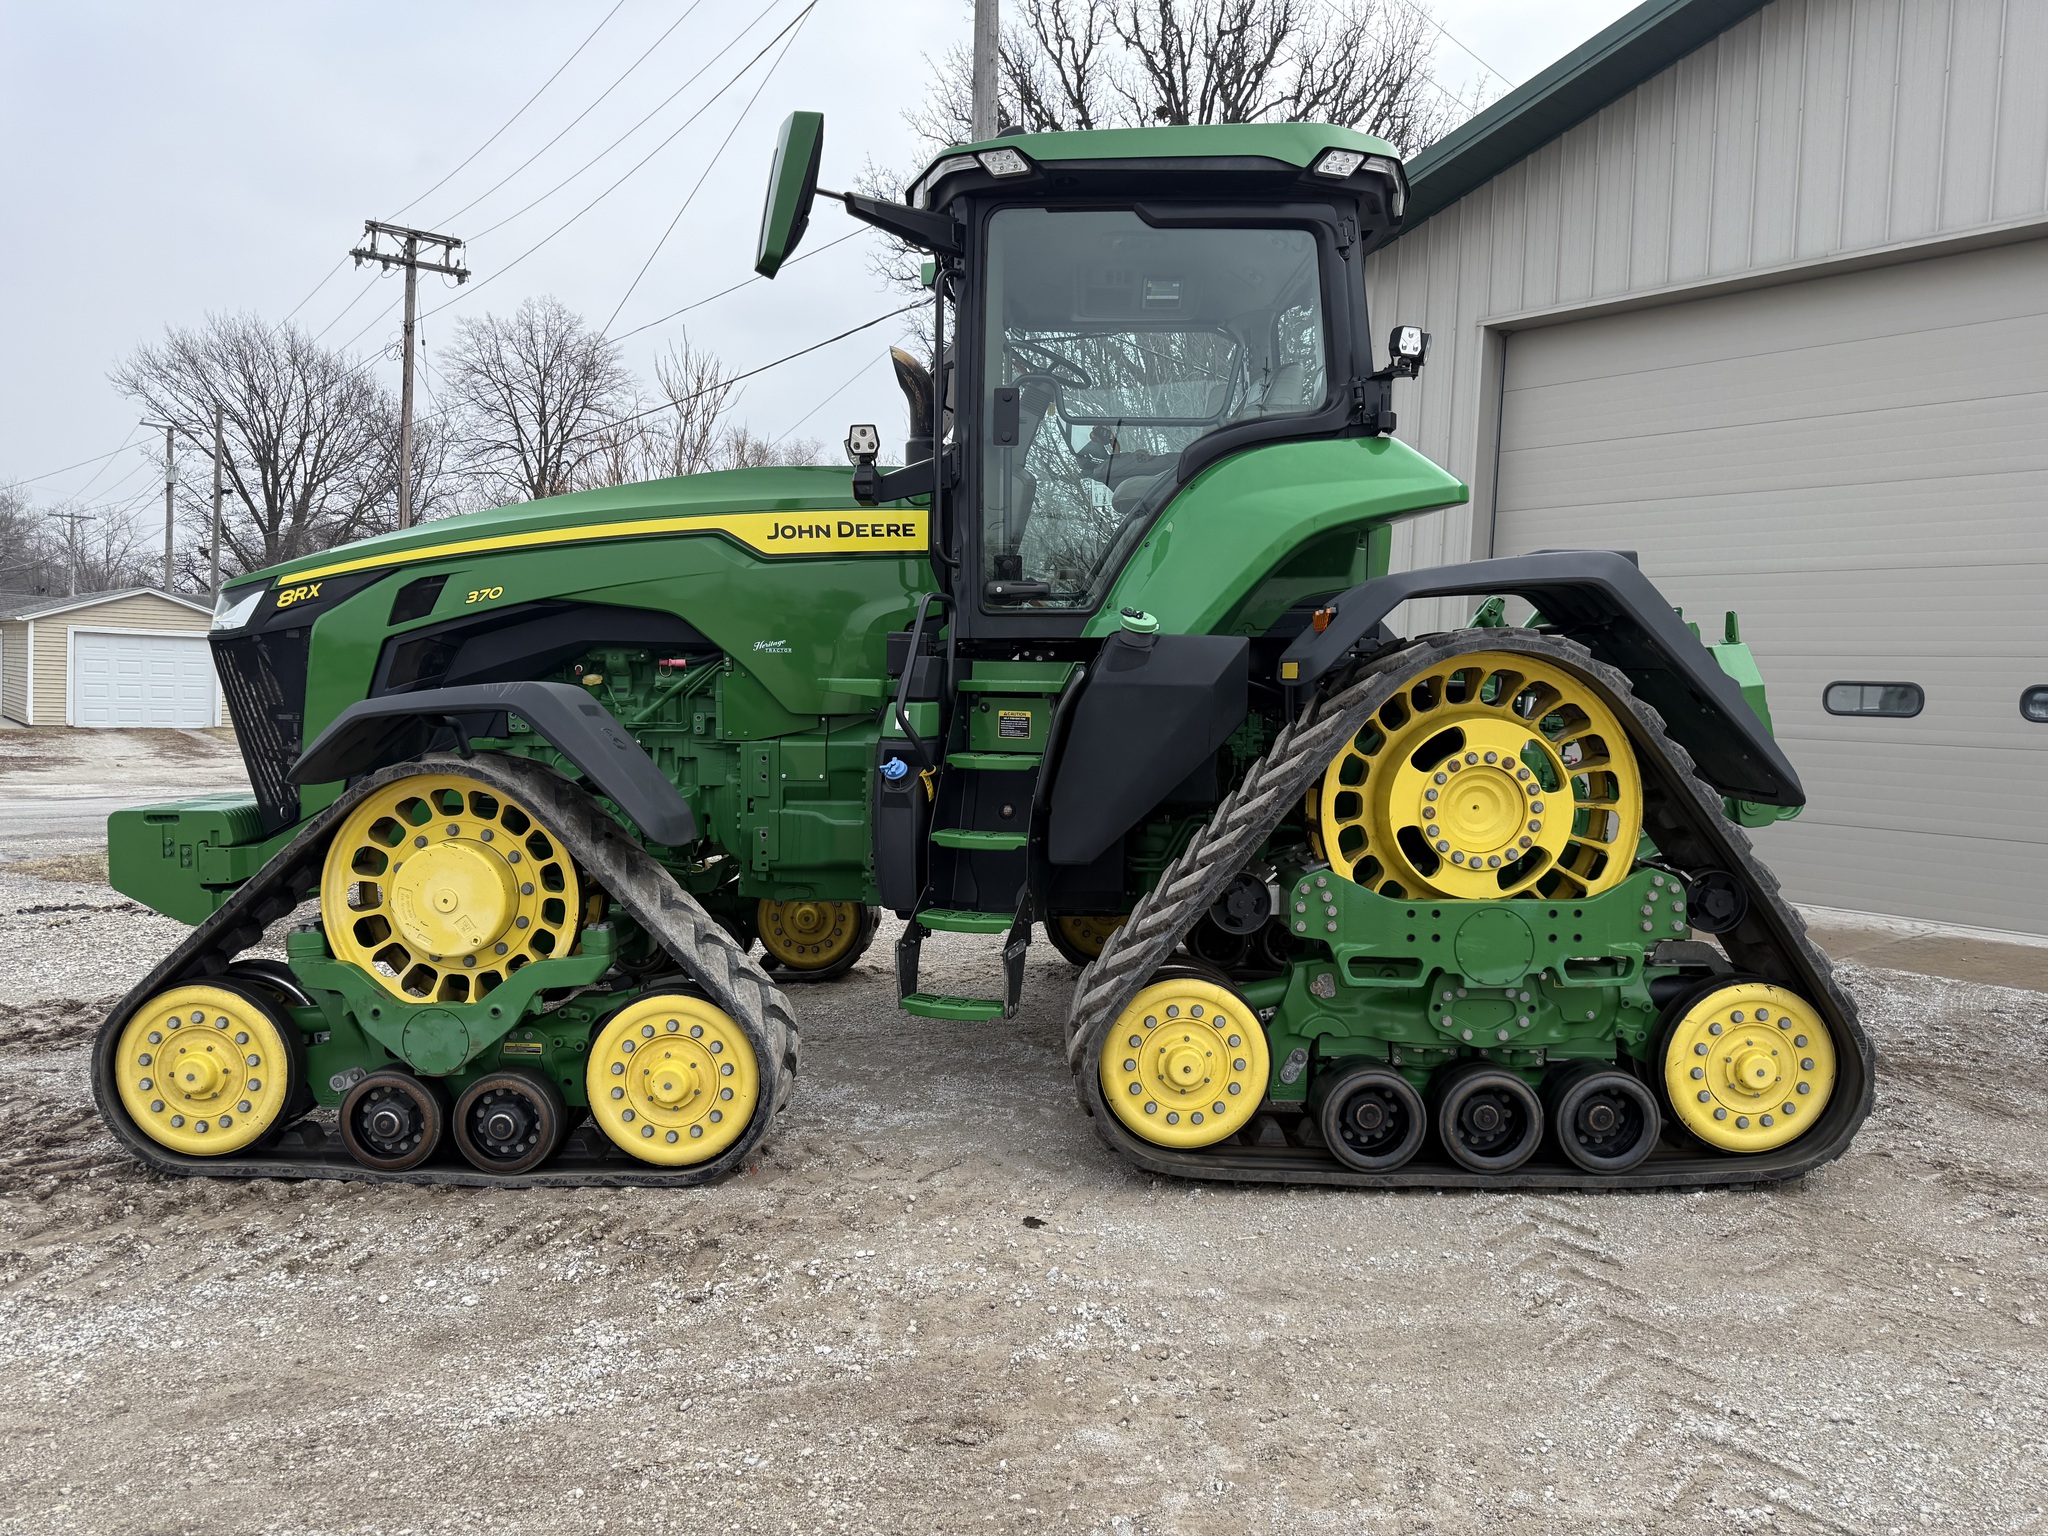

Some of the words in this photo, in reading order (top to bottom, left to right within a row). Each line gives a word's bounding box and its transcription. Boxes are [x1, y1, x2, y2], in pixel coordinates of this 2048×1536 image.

[766, 522, 831, 540] JOHN
[837, 521, 916, 538] DEERE
[276, 582, 323, 608] 8RX
[465, 586, 504, 604] 370
[753, 639, 787, 651] Heritage
